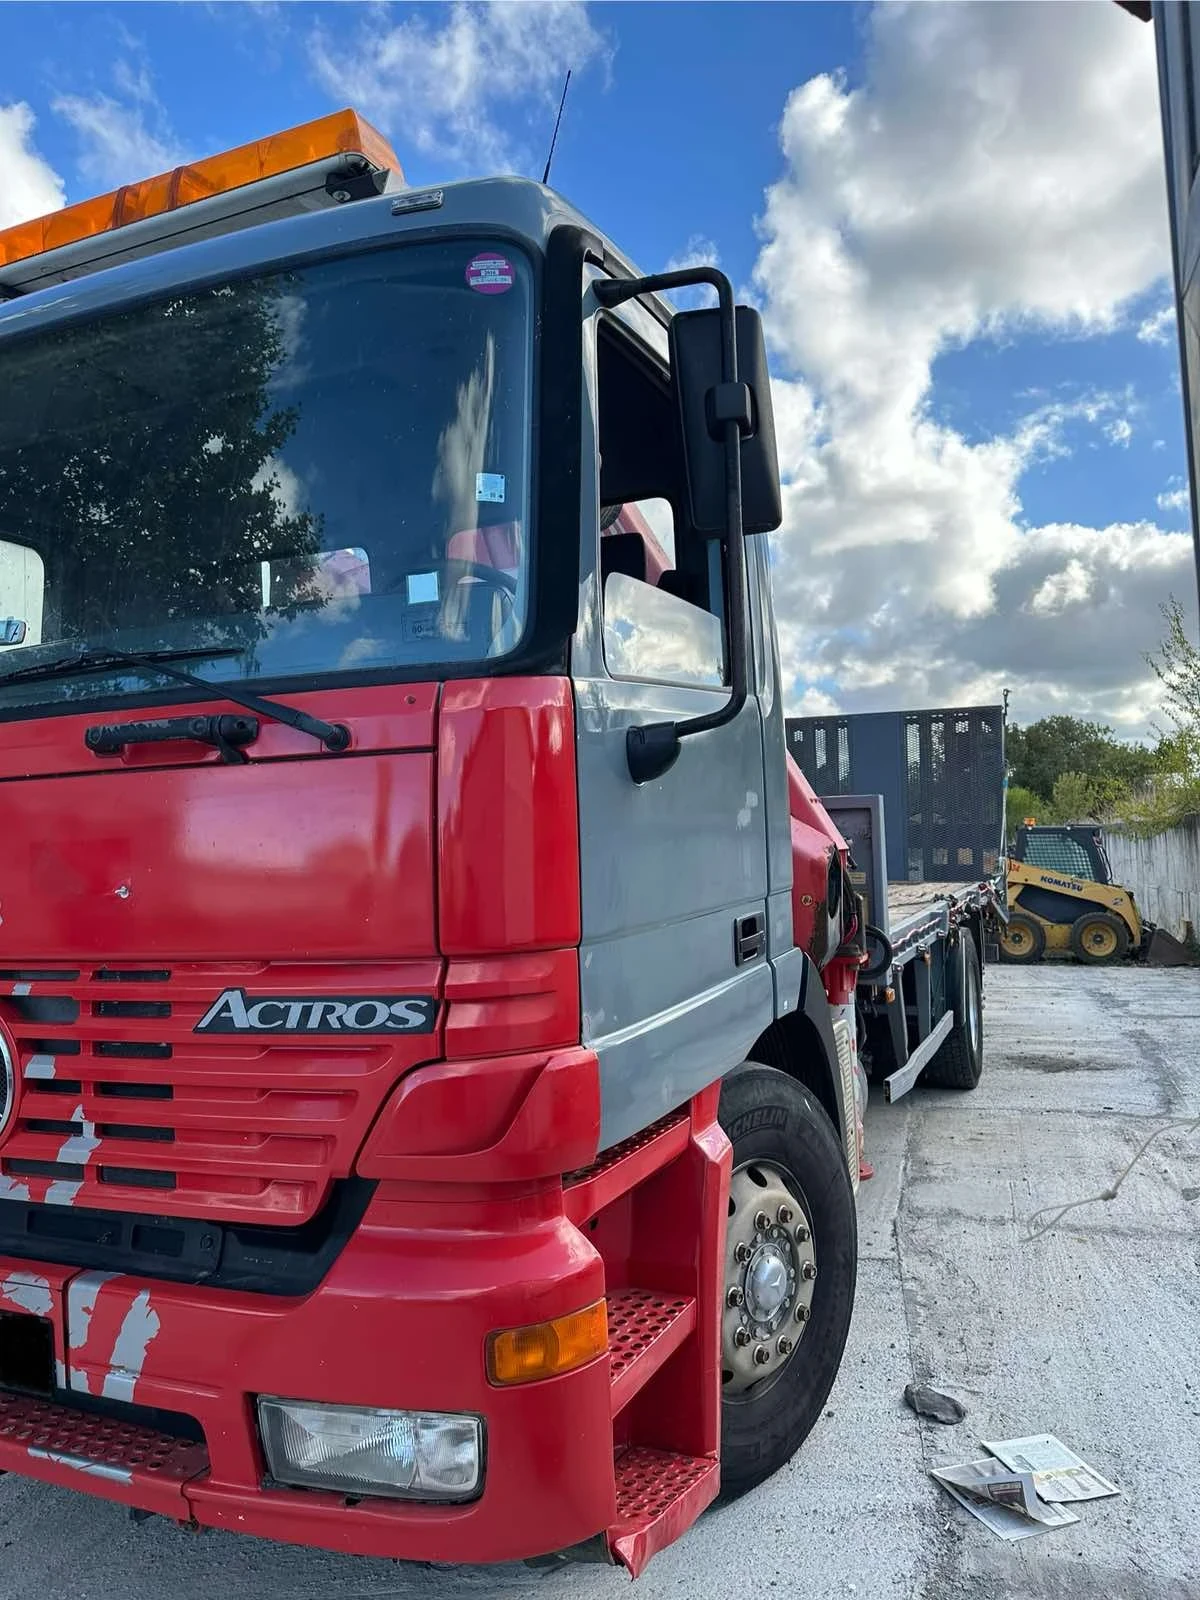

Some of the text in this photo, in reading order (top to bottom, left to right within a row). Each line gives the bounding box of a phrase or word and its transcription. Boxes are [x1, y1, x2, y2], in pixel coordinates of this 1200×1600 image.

[1040, 876, 1083, 891] KOMATSU
[197, 990, 428, 1028] ACTROS
[727, 1107, 788, 1139] ICHELIN
